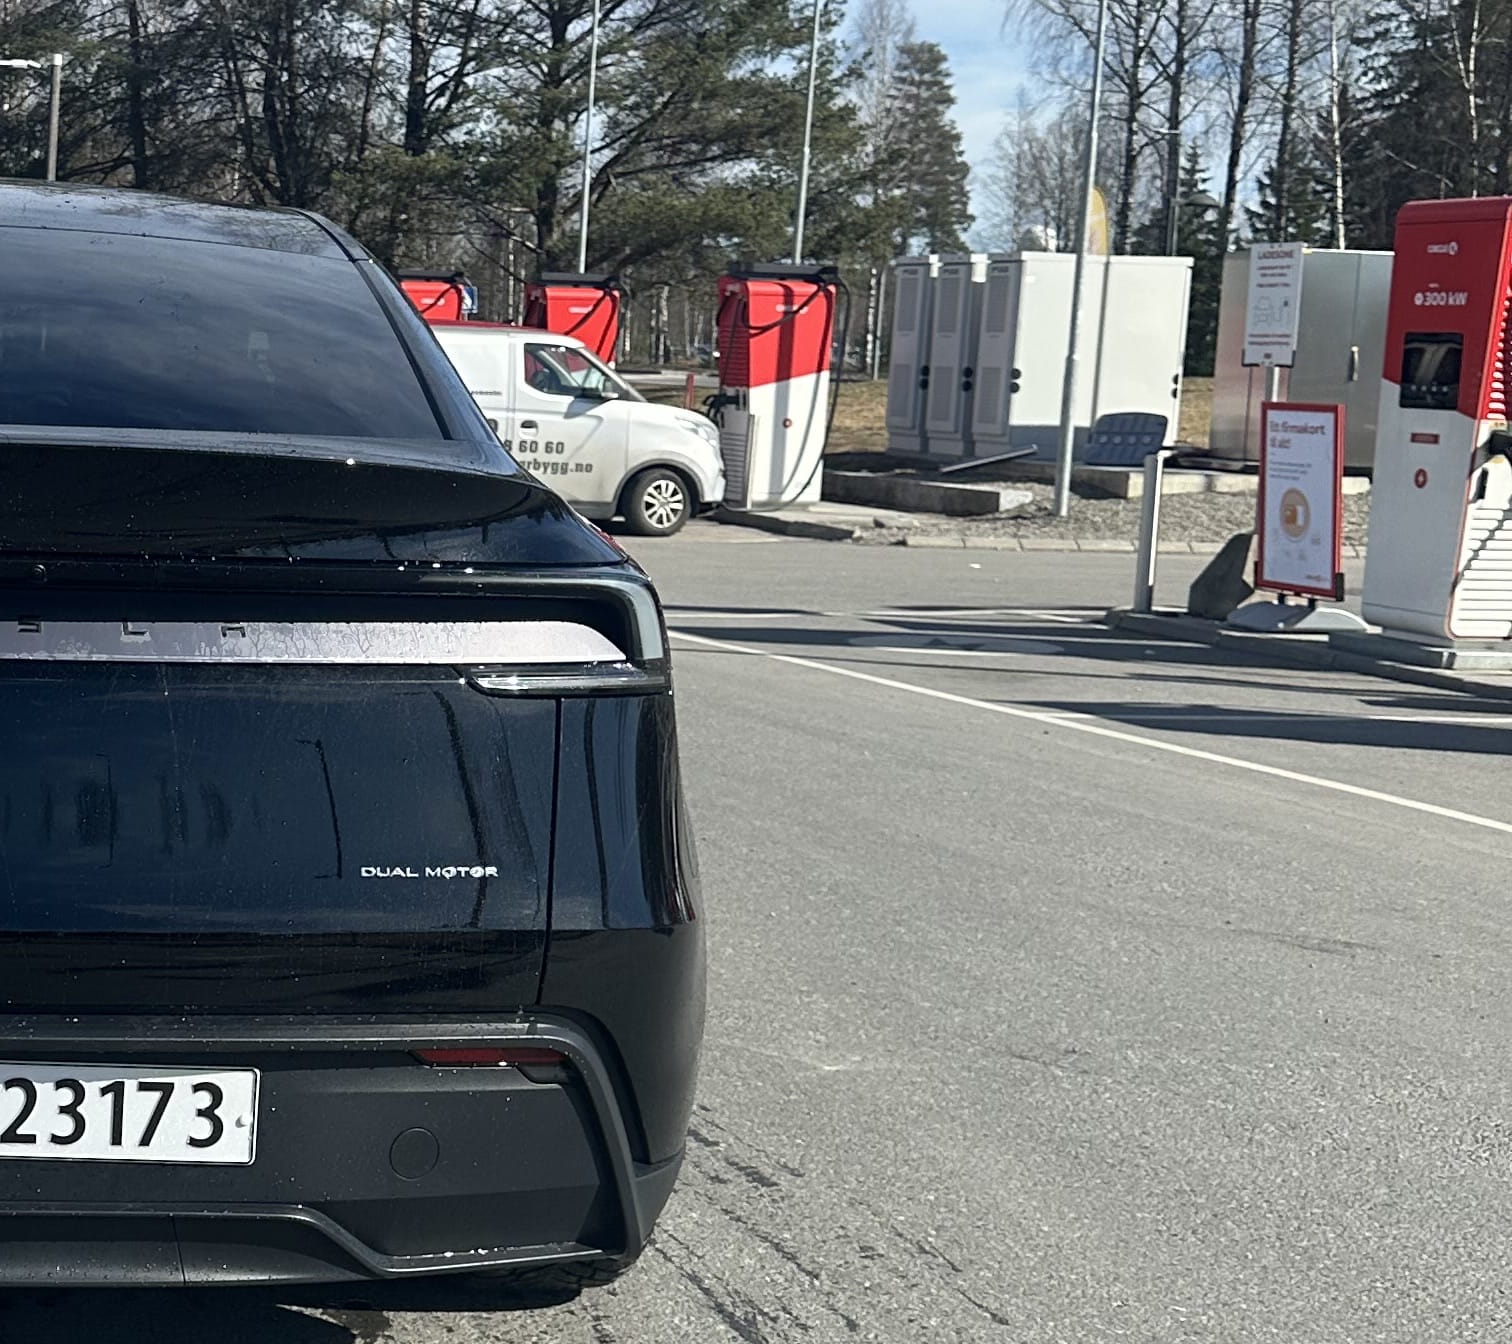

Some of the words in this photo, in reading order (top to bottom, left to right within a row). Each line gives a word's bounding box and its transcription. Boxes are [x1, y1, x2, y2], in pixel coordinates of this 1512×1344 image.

[1424, 291, 1447, 306] 300
[1448, 291, 1468, 306] kW
[519, 441, 539, 454] 60
[545, 441, 565, 454] 60
[360, 866, 419, 878] DUAL
[425, 866, 499, 880] MOTOR
[0, 1076, 224, 1148] 23173
